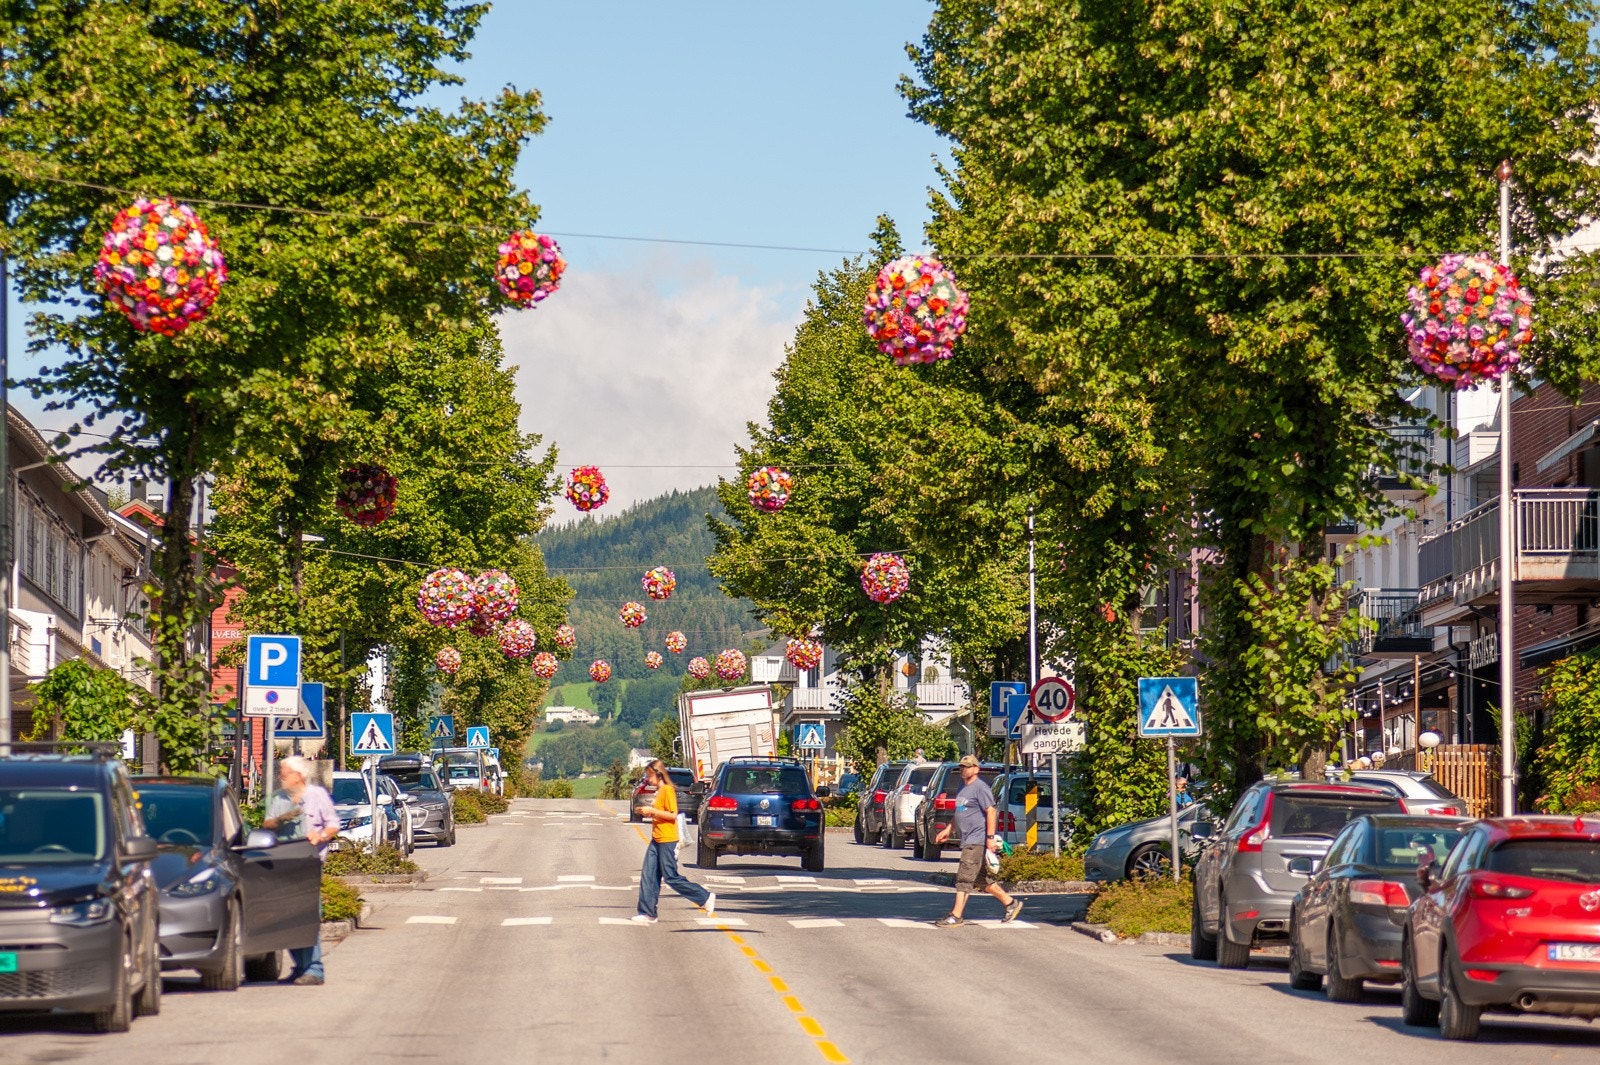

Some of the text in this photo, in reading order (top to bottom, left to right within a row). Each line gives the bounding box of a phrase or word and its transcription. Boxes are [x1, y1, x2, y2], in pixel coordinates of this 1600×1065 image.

[260, 643, 288, 680] P
[1000, 687, 1018, 713] P
[1037, 688, 1067, 710] 40
[1034, 727, 1072, 735] Hevede
[1033, 738, 1074, 749] gangfelt
